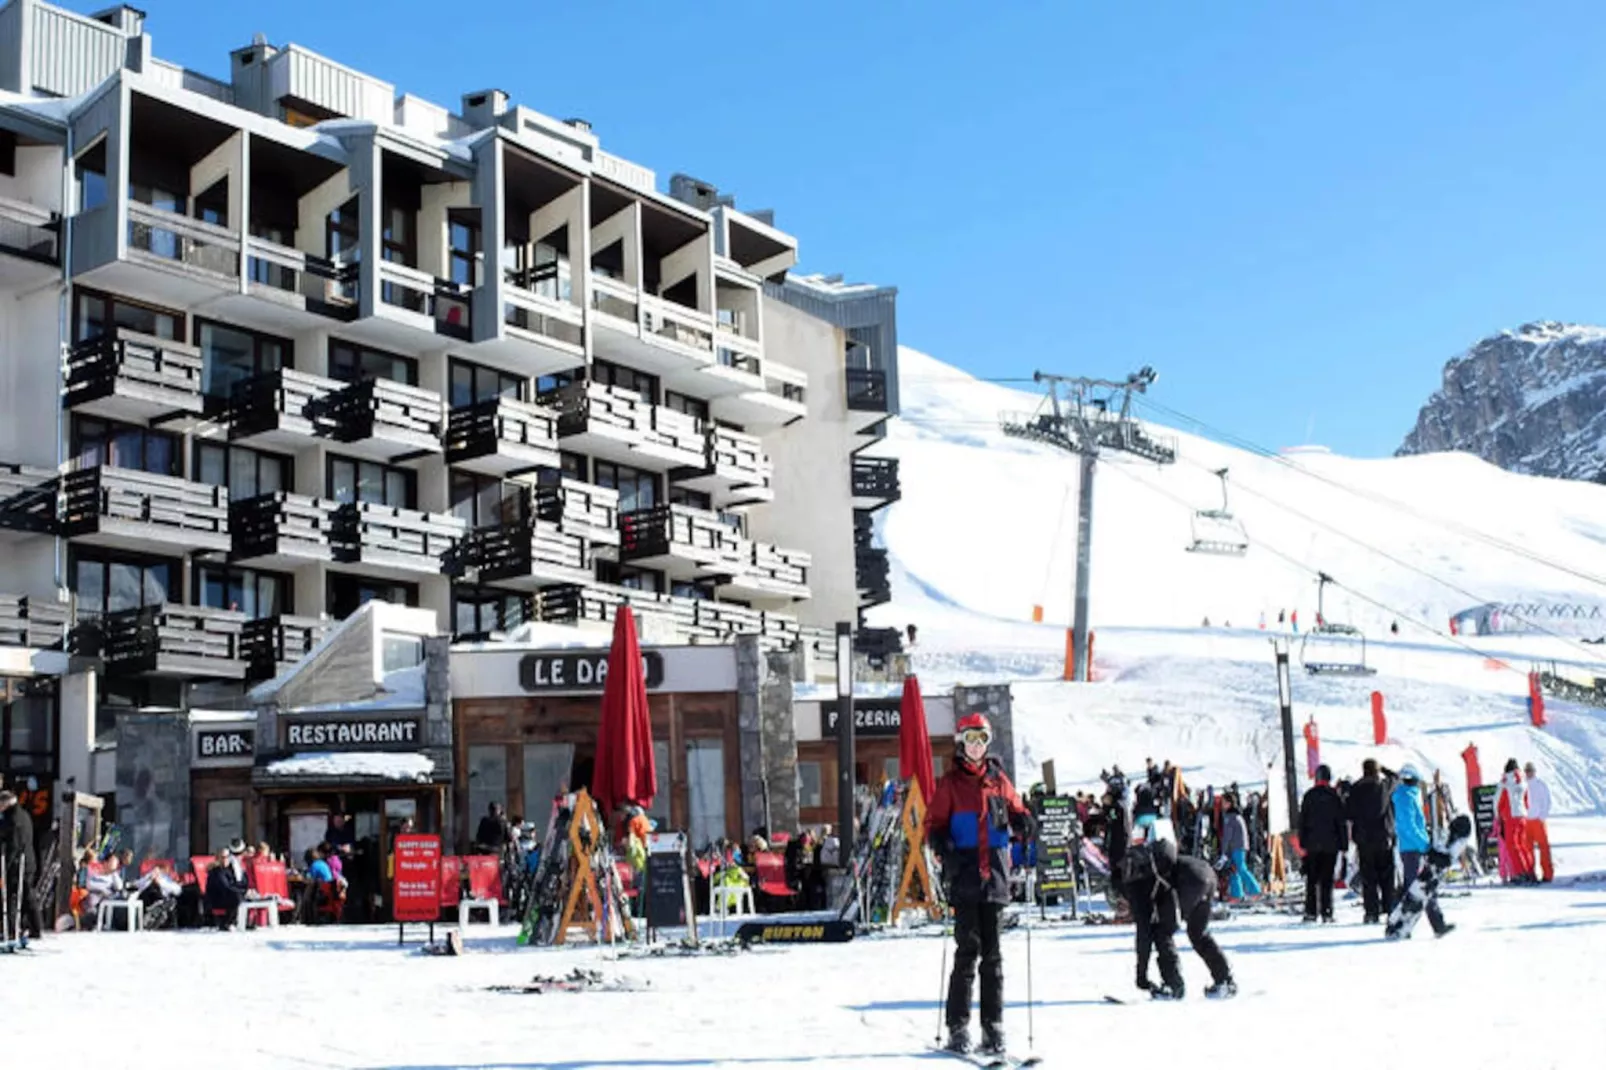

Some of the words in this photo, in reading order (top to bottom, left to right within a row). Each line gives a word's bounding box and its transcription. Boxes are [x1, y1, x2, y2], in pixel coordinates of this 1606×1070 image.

[535, 659, 565, 685] LE
[828, 710, 901, 728] PZERIA
[289, 723, 416, 743] RESTAURANT
[202, 735, 242, 754] BAR
